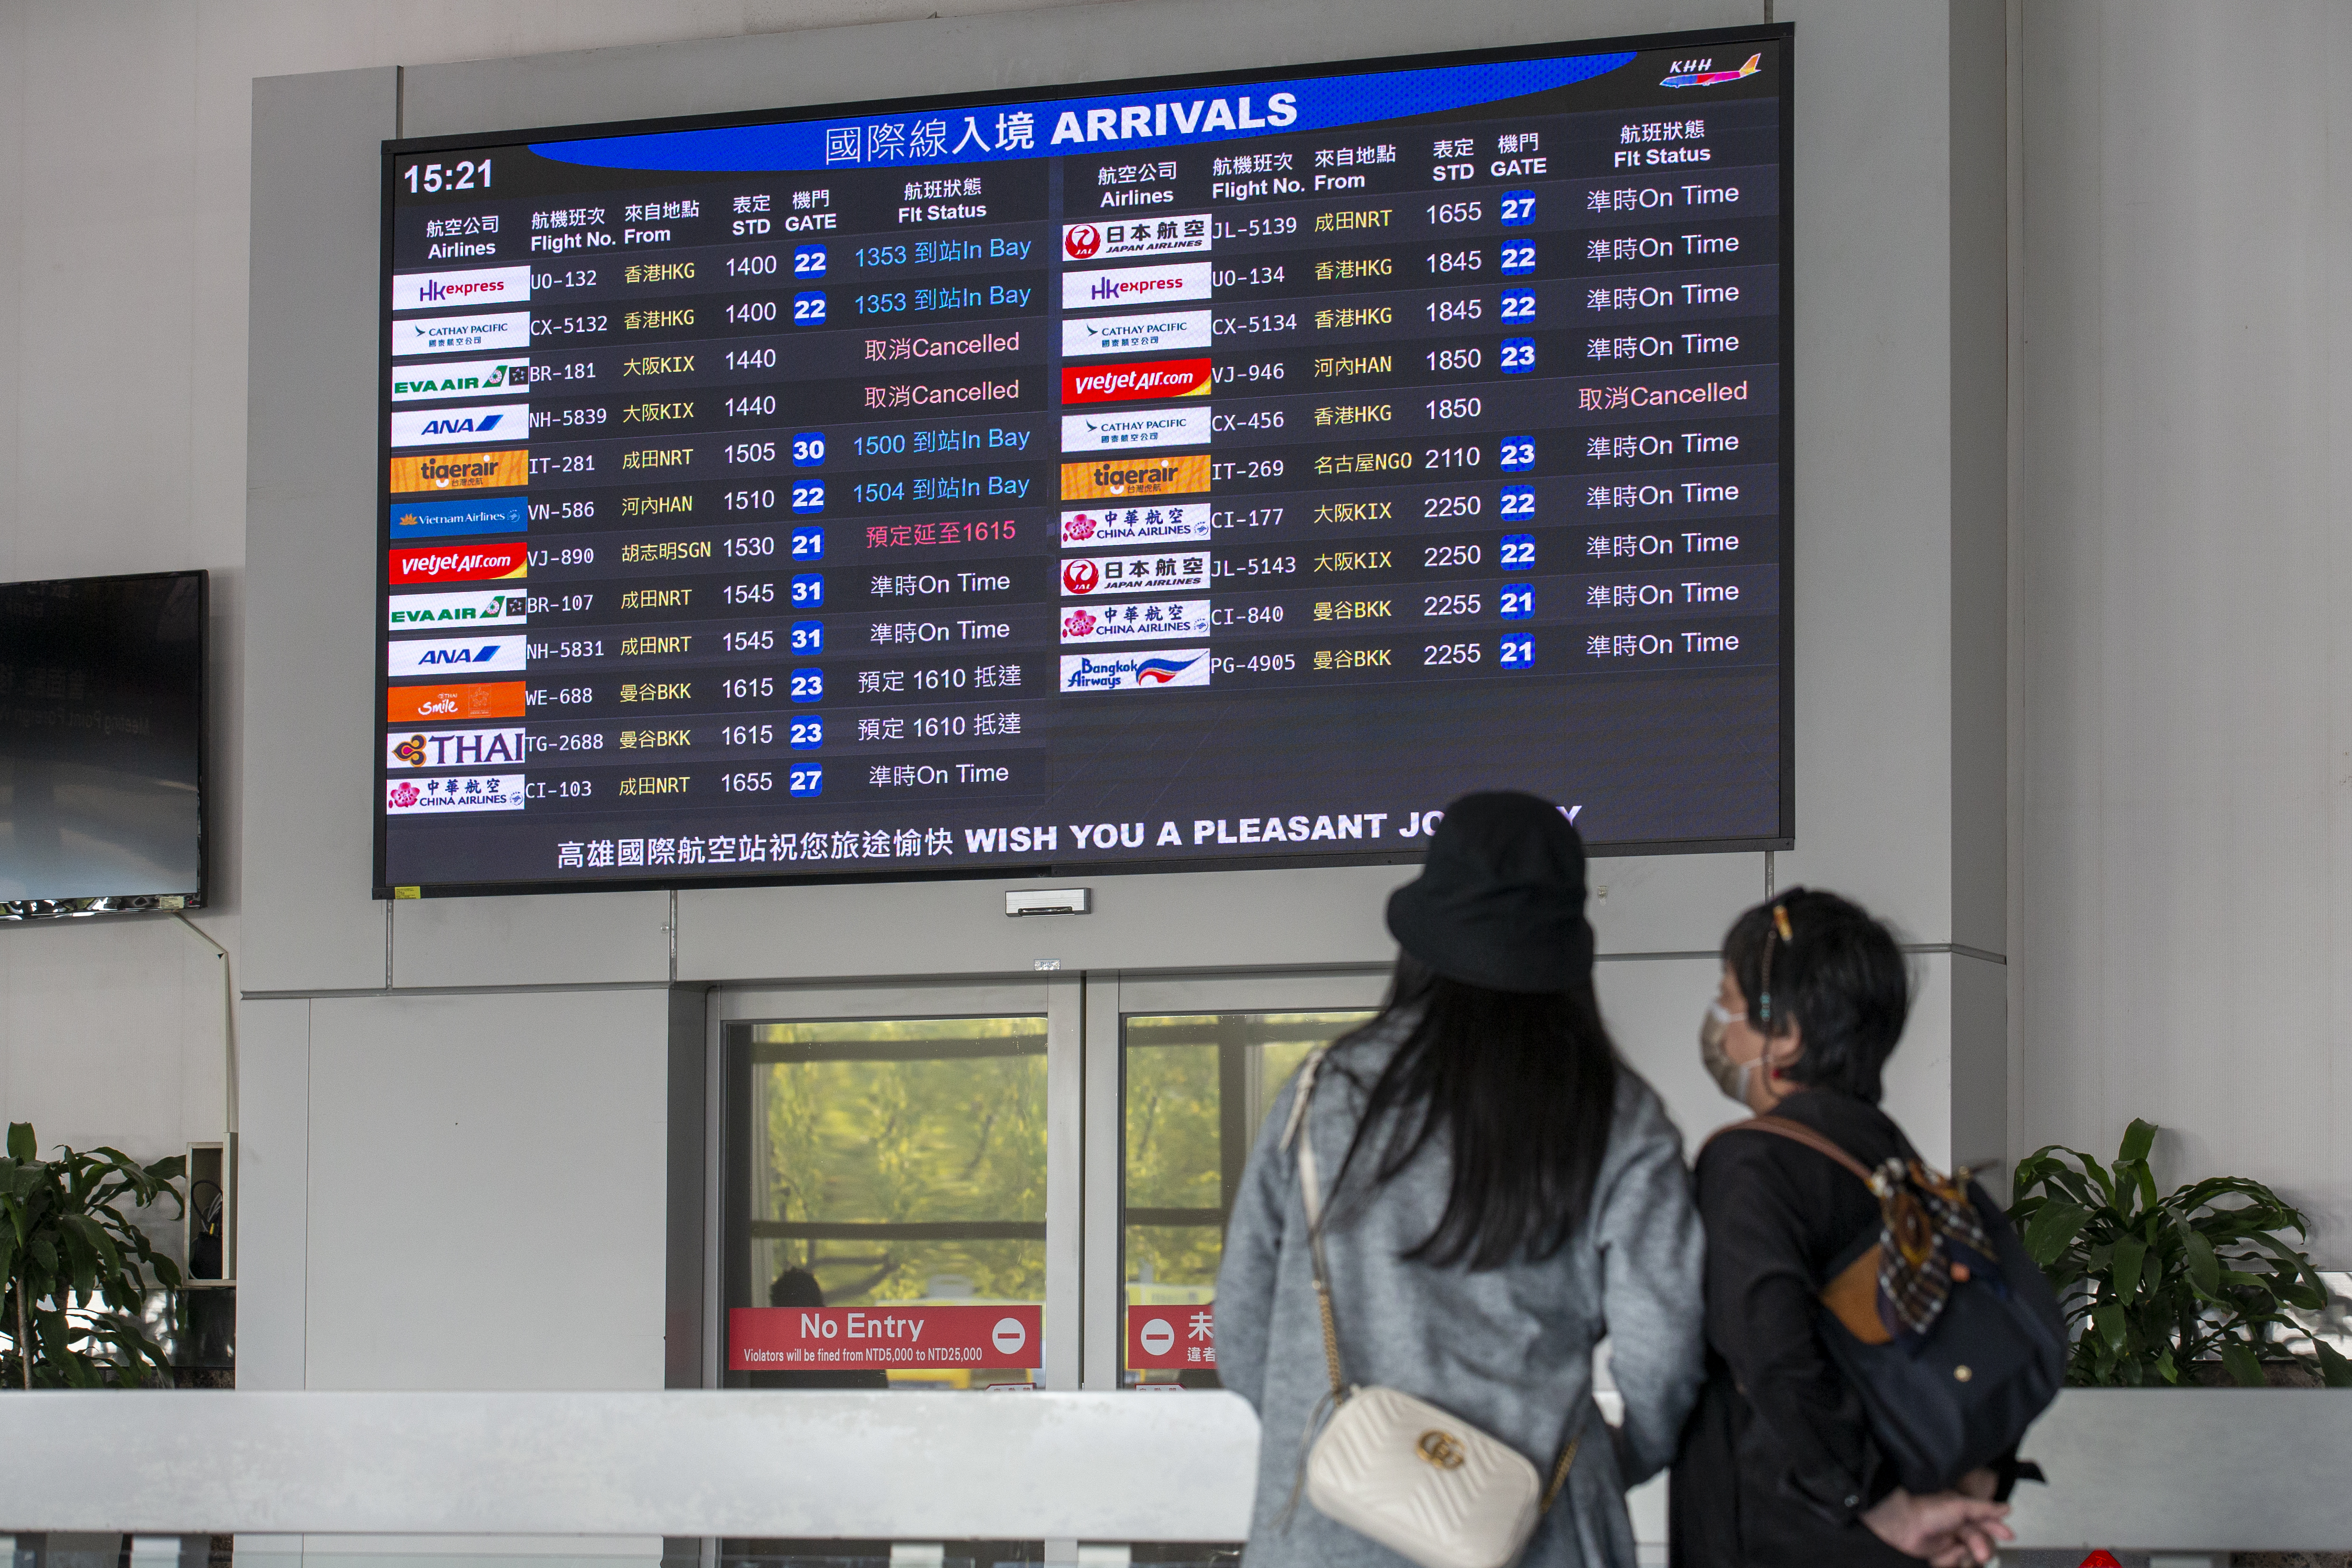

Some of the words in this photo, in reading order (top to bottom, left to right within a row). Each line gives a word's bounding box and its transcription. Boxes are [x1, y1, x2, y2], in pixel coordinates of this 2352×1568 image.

[1670, 59, 1712, 74] KHH
[826, 112, 1034, 165] 國際線入境
[1051, 93, 1297, 144] ARRIVALS
[404, 159, 491, 193] 15:21
[904, 178, 981, 201] 航班狀態
[733, 194, 770, 214] 表定
[792, 190, 829, 210] 機門
[532, 207, 605, 230] 航機班次
[625, 200, 699, 222] 來自地點
[899, 207, 922, 223] Flt
[927, 204, 986, 220] Status
[1212, 217, 1297, 240] JL-5139
[1427, 202, 1481, 224] 1655
[1502, 198, 1535, 218] 27
[1681, 185, 1739, 205] Time
[427, 216, 498, 238] 航空公司
[732, 219, 770, 235] STD
[785, 213, 836, 232] GATE
[1106, 220, 1205, 244] 日本航空
[531, 233, 582, 254] Flight
[587, 232, 616, 247] No.
[625, 229, 670, 244] From
[1147, 240, 1202, 250] AIRLINES
[428, 242, 496, 259] Airlines
[531, 271, 597, 289] UO-132
[727, 255, 777, 276] 1400
[795, 253, 825, 272] 22
[856, 246, 907, 267] 1353
[990, 238, 1031, 260] Bay
[1212, 266, 1285, 287] UO-134
[1426, 251, 1481, 272] 1845
[429, 326, 469, 336] CATHAY
[471, 323, 507, 334] PACIFIC
[531, 317, 607, 335] CX-5132
[1102, 324, 1144, 336] CATHAY
[1147, 322, 1187, 333] PACIFIC
[1212, 314, 1297, 335] CX-5134
[530, 363, 596, 382] BR-181
[726, 349, 776, 370] 1440
[1212, 364, 1284, 384] VJ-946
[1426, 348, 1481, 370] 1850
[422, 419, 473, 434] ANA
[529, 408, 606, 428] NH-5839
[1212, 412, 1284, 432] CX-456
[529, 456, 594, 474] IT-281
[725, 442, 775, 463] 1505
[794, 441, 824, 460] 30
[854, 435, 905, 455] 1500
[989, 428, 1030, 451] Bay
[1212, 461, 1284, 480] IT-269
[1425, 447, 1480, 469] 2110
[1501, 444, 1534, 464] 23
[1681, 433, 1739, 452] Time
[528, 502, 594, 520] VN-586
[724, 490, 774, 510] 1510
[793, 488, 824, 507] 22
[1211, 508, 1284, 529] CI-177
[1424, 496, 1481, 517] 2250
[419, 514, 464, 525] Vietnam
[465, 512, 504, 522] Airlines
[528, 548, 593, 567] VJ-890
[724, 537, 774, 557] 1530
[793, 535, 820, 554] 21
[866, 520, 1015, 548] 預定延至1615
[1211, 557, 1296, 577] JL-5143
[527, 595, 593, 613] BR-107
[723, 584, 774, 604] 1545
[957, 573, 1010, 592] Time
[1211, 606, 1284, 626] CI-840
[527, 640, 604, 659] NH-5831
[1211, 654, 1295, 674] PG-4905
[1424, 643, 1481, 665] 2255
[1081, 658, 1138, 677] Bangkok
[525, 687, 592, 706] WE-688
[723, 678, 773, 698] 1615
[791, 676, 822, 695] 23
[858, 670, 904, 693] 預定
[914, 669, 965, 689] 1610
[974, 665, 1021, 688] 抵達
[1068, 674, 1122, 688] Airways
[525, 734, 603, 752] TG-2688
[428, 779, 500, 795] 中華航空
[525, 780, 592, 798] CI-103
[722, 772, 772, 792] 1655
[791, 771, 821, 790] 27
[956, 764, 1009, 782] Time
[420, 797, 455, 806] CHINA
[458, 795, 506, 804] AIRLINES
[558, 827, 953, 869] 高雄國際航空站祝您旅途愉快
[965, 826, 1057, 853] WISH
[1069, 822, 1144, 849] YOU
[1156, 821, 1182, 846] A
[1194, 813, 1387, 845] PLEASANT
[802, 1314, 837, 1338] No
[848, 1314, 924, 1342] Entry
[744, 1350, 783, 1361] Violators
[787, 1349, 801, 1361] will
[805, 1349, 815, 1361] be
[818, 1349, 839, 1361] fined
[843, 1349, 862, 1361] from
[866, 1348, 913, 1361] NTD5,000
[916, 1350, 925, 1361] to
[928, 1348, 982, 1361] NTD25,000
